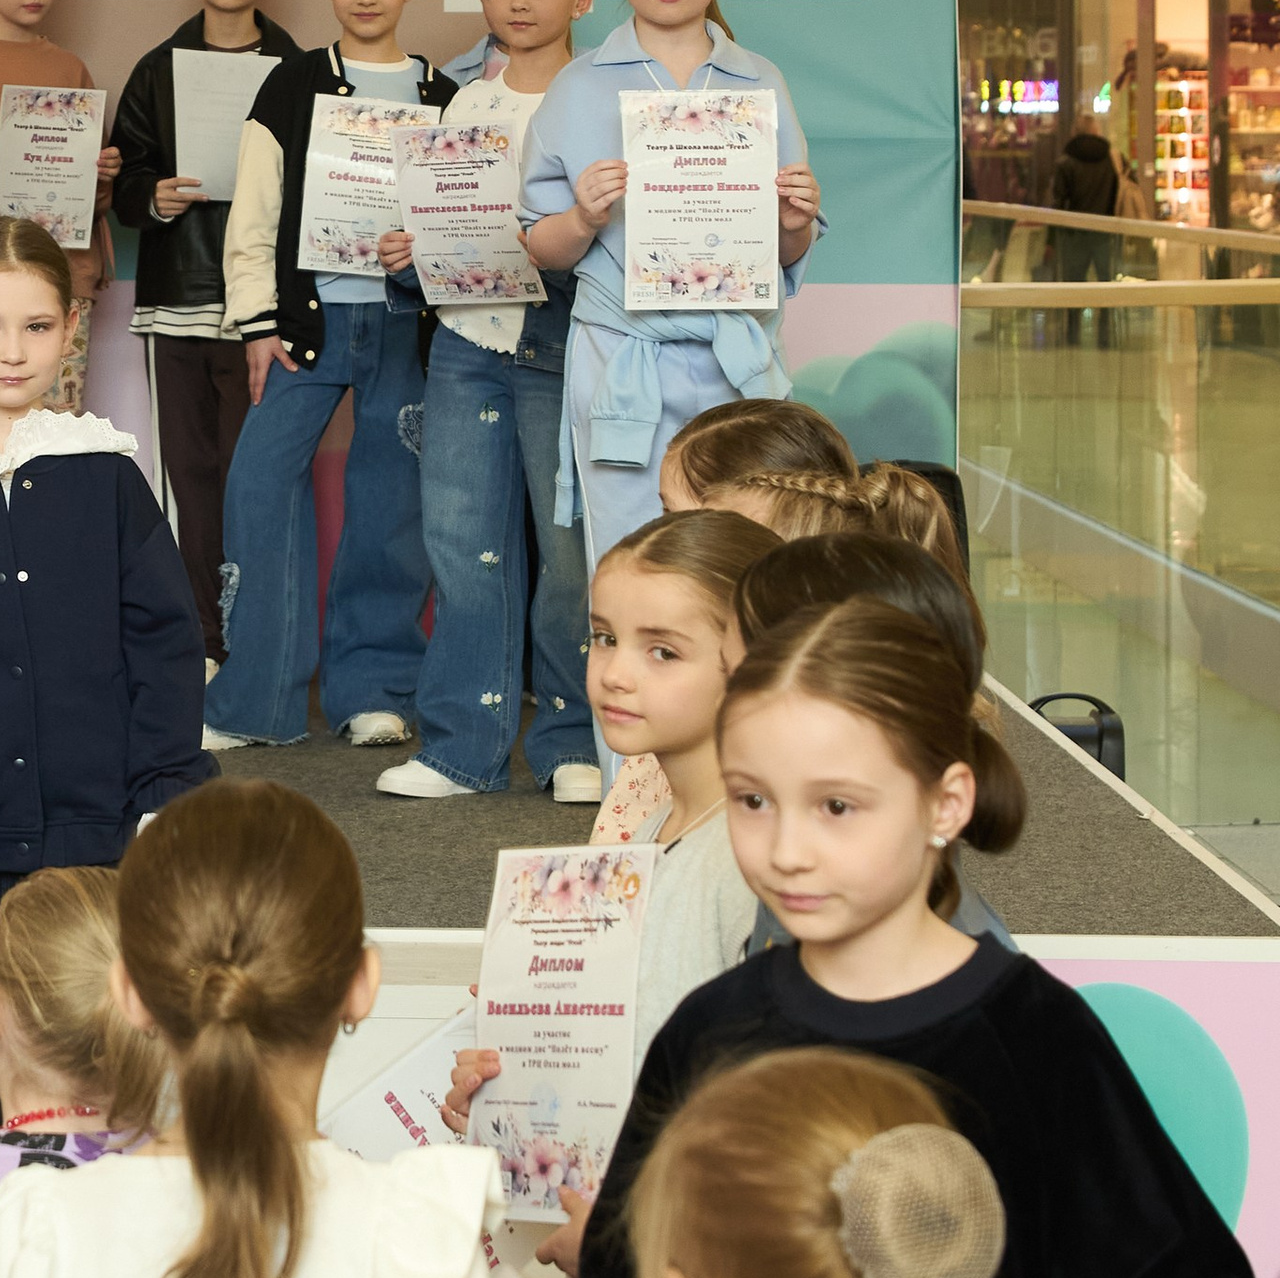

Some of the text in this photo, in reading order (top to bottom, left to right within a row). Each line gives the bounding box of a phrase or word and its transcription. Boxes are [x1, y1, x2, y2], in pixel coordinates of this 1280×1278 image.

[31, 133, 68, 143] Диплом
[646, 144, 668, 152] Театр
[350, 151, 393, 163] Диплом
[673, 156, 727, 168] Диплом
[328, 170, 382, 184] Соболева
[435, 181, 479, 193] Диплом
[643, 182, 761, 193] Бондаренко Николь
[410, 203, 513, 214] Пантелеева Варвара
[528, 955, 585, 976] Диплом
[487, 1000, 551, 1015] Васильева
[542, 1031, 571, 1040] участие
